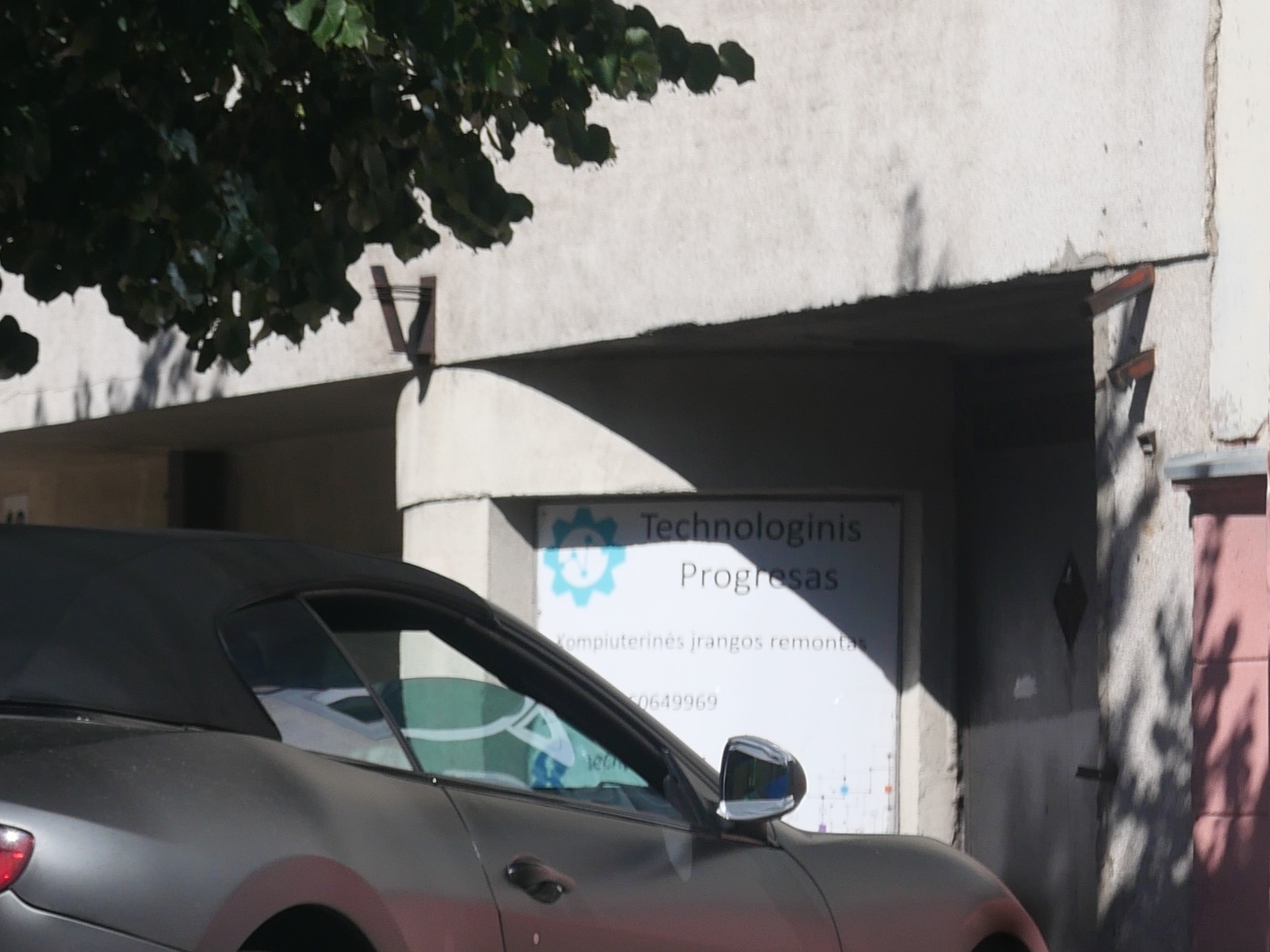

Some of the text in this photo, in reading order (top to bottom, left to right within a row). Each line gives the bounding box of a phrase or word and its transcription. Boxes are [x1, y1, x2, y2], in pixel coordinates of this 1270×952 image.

[640, 512, 862, 547] Technologinis
[680, 561, 839, 595] Progresas
[770, 633, 867, 652] remontas
